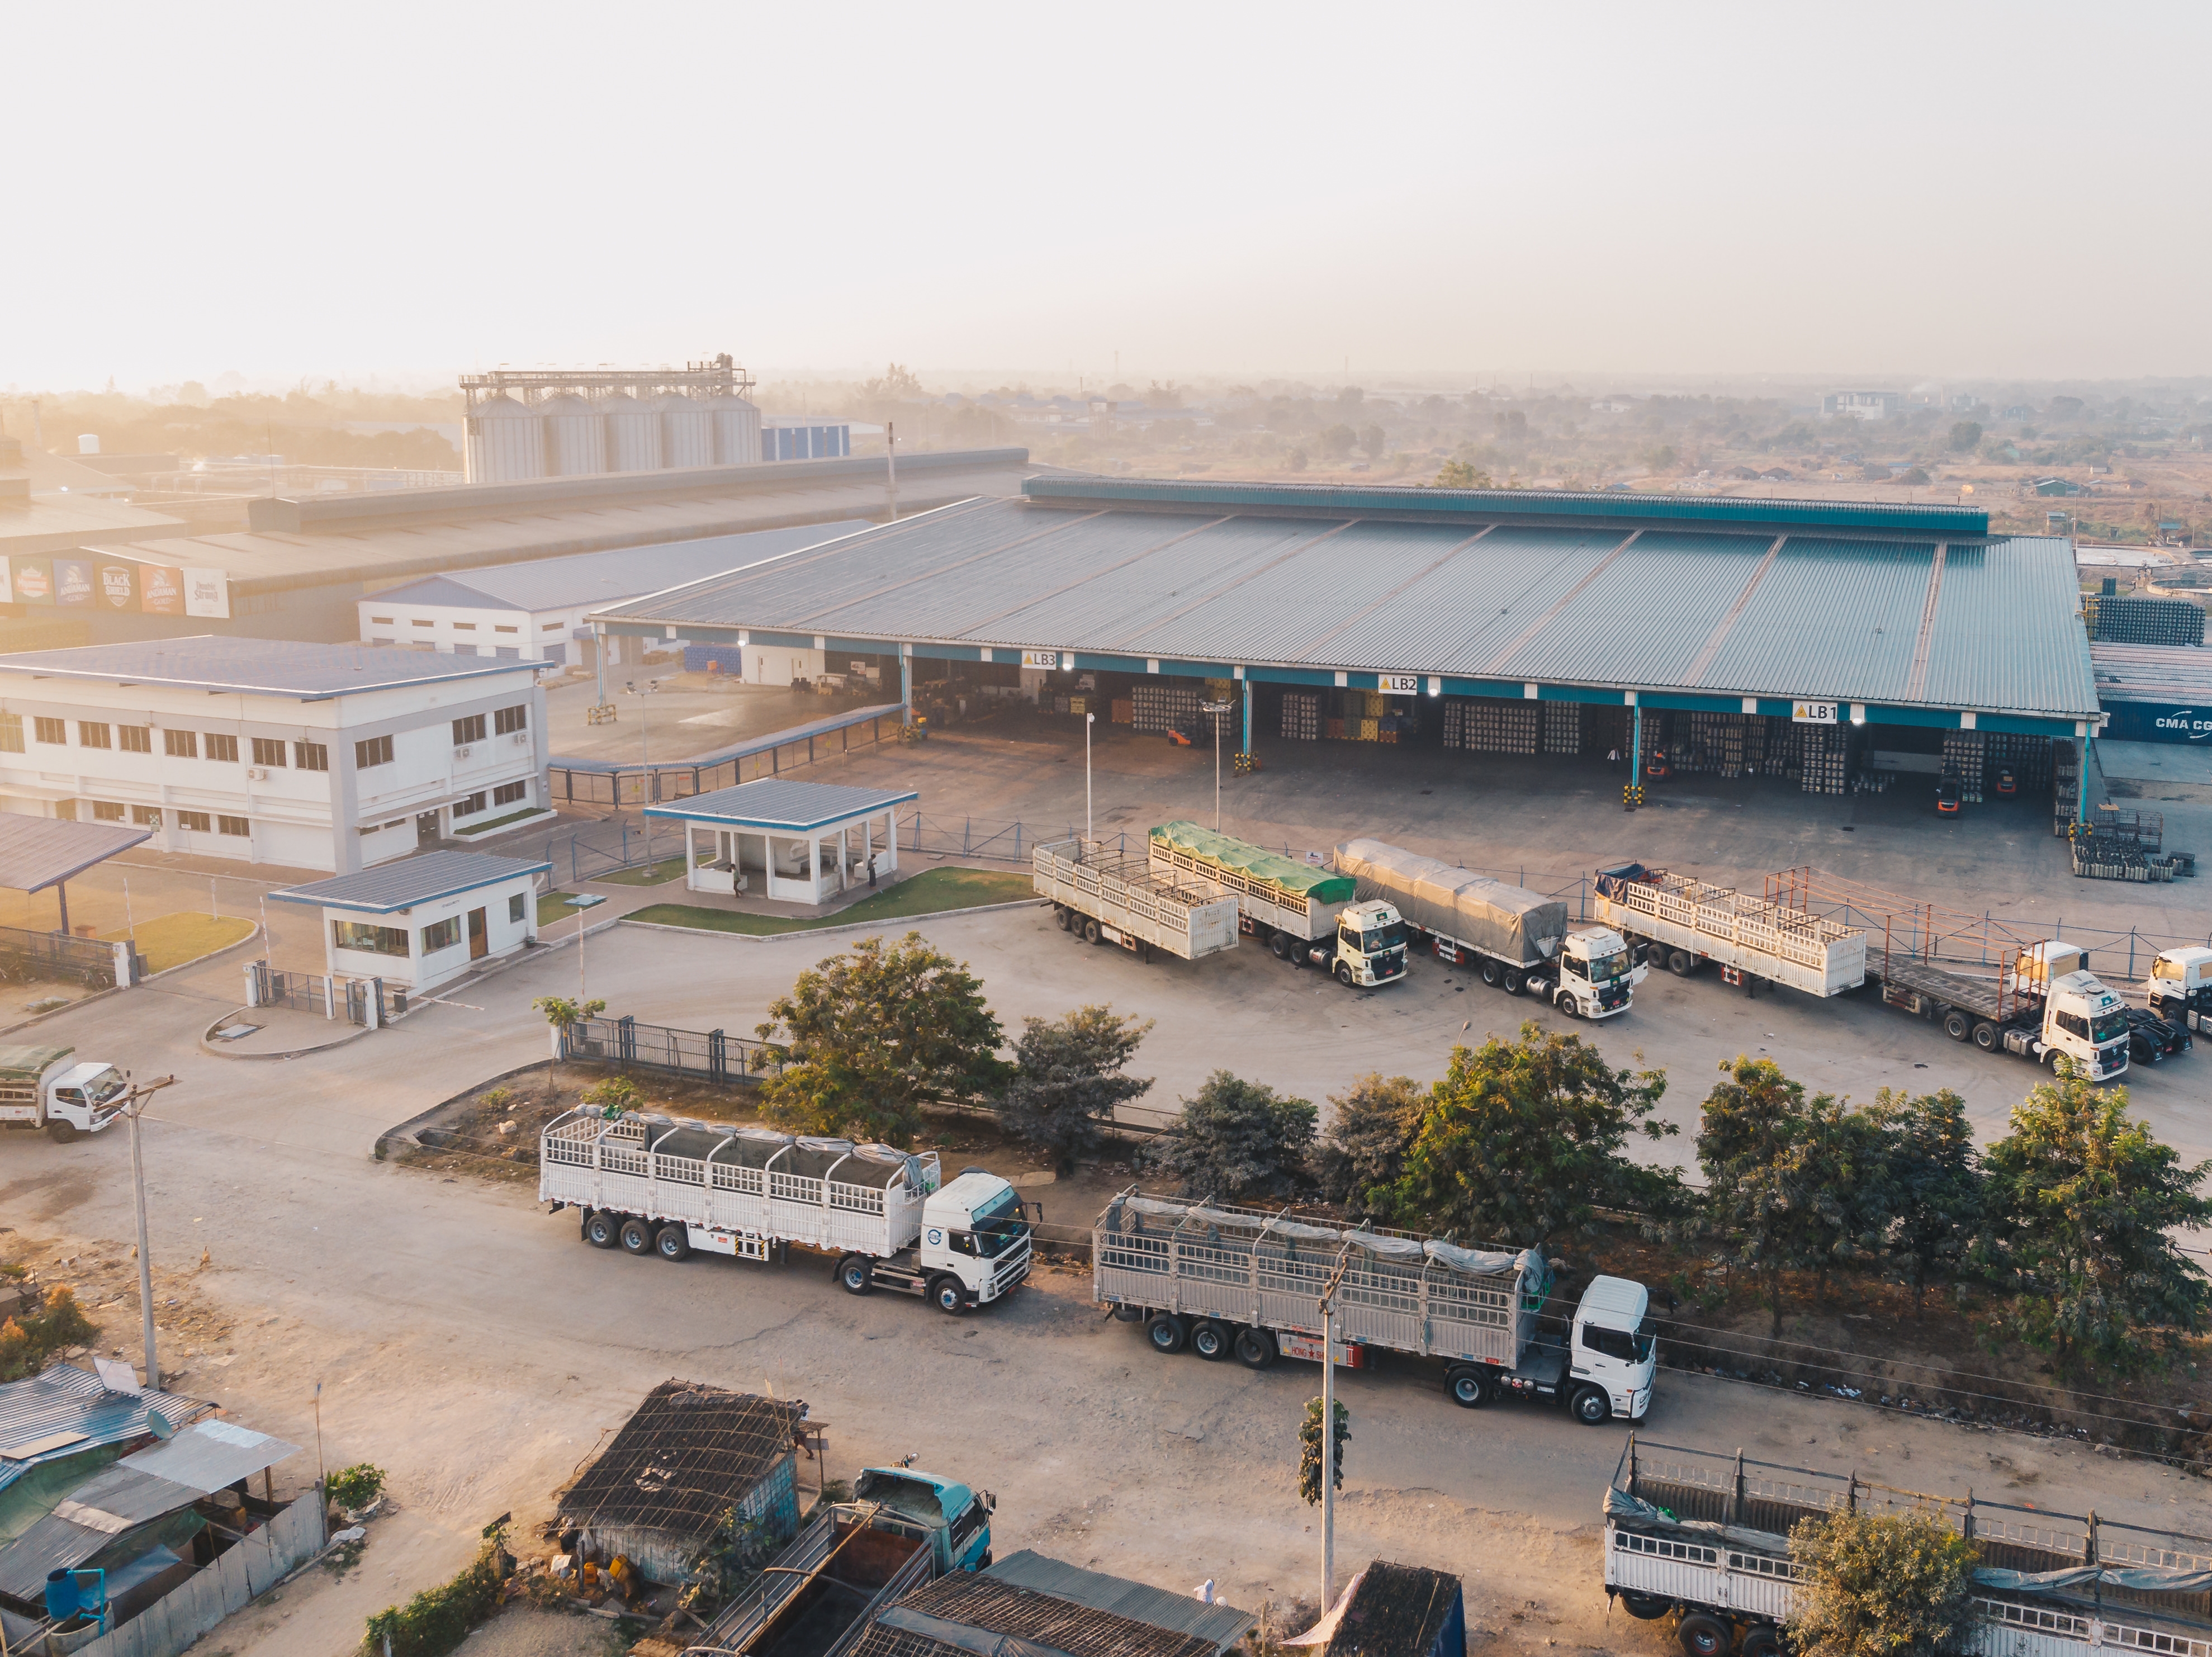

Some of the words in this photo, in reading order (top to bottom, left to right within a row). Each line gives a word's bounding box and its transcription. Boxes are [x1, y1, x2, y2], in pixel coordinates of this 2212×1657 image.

[103, 572, 131, 586] BLACK
[60, 584, 89, 596] ANDAMAN
[105, 585, 130, 596] SHIELD
[147, 588, 177, 599] ANDAMAN
[194, 590, 218, 602] Strong
[1034, 654, 1055, 665] LB3
[1392, 678, 1416, 690] LB2
[1809, 705, 1836, 719] LB1
[2156, 718, 2189, 729] CMA
[1292, 1347, 1307, 1357] HONG
